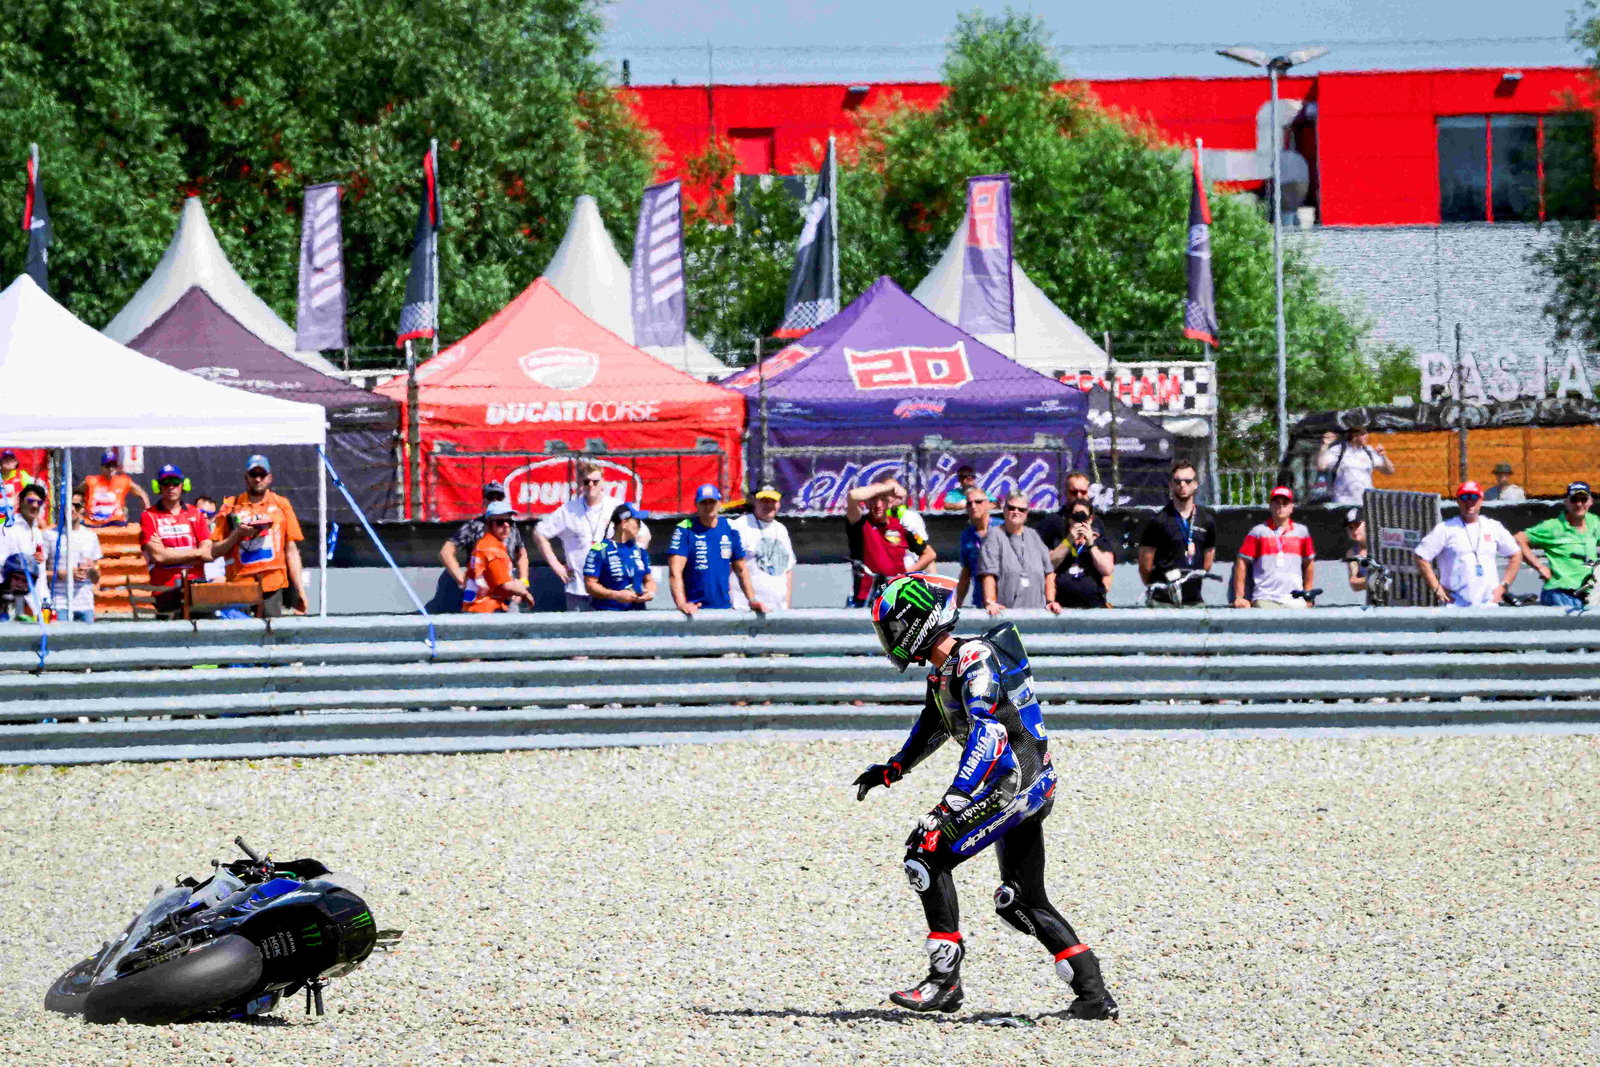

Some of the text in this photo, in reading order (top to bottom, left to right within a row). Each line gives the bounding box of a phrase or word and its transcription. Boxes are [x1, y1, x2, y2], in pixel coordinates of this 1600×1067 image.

[844, 341, 973, 391] 20
[518, 480, 627, 505] DUCTI
[900, 617, 922, 648] MONSTER
[910, 603, 941, 655] SCORPION
[958, 735, 988, 781] YAMAHA
[956, 788, 1004, 824] MONSTER
